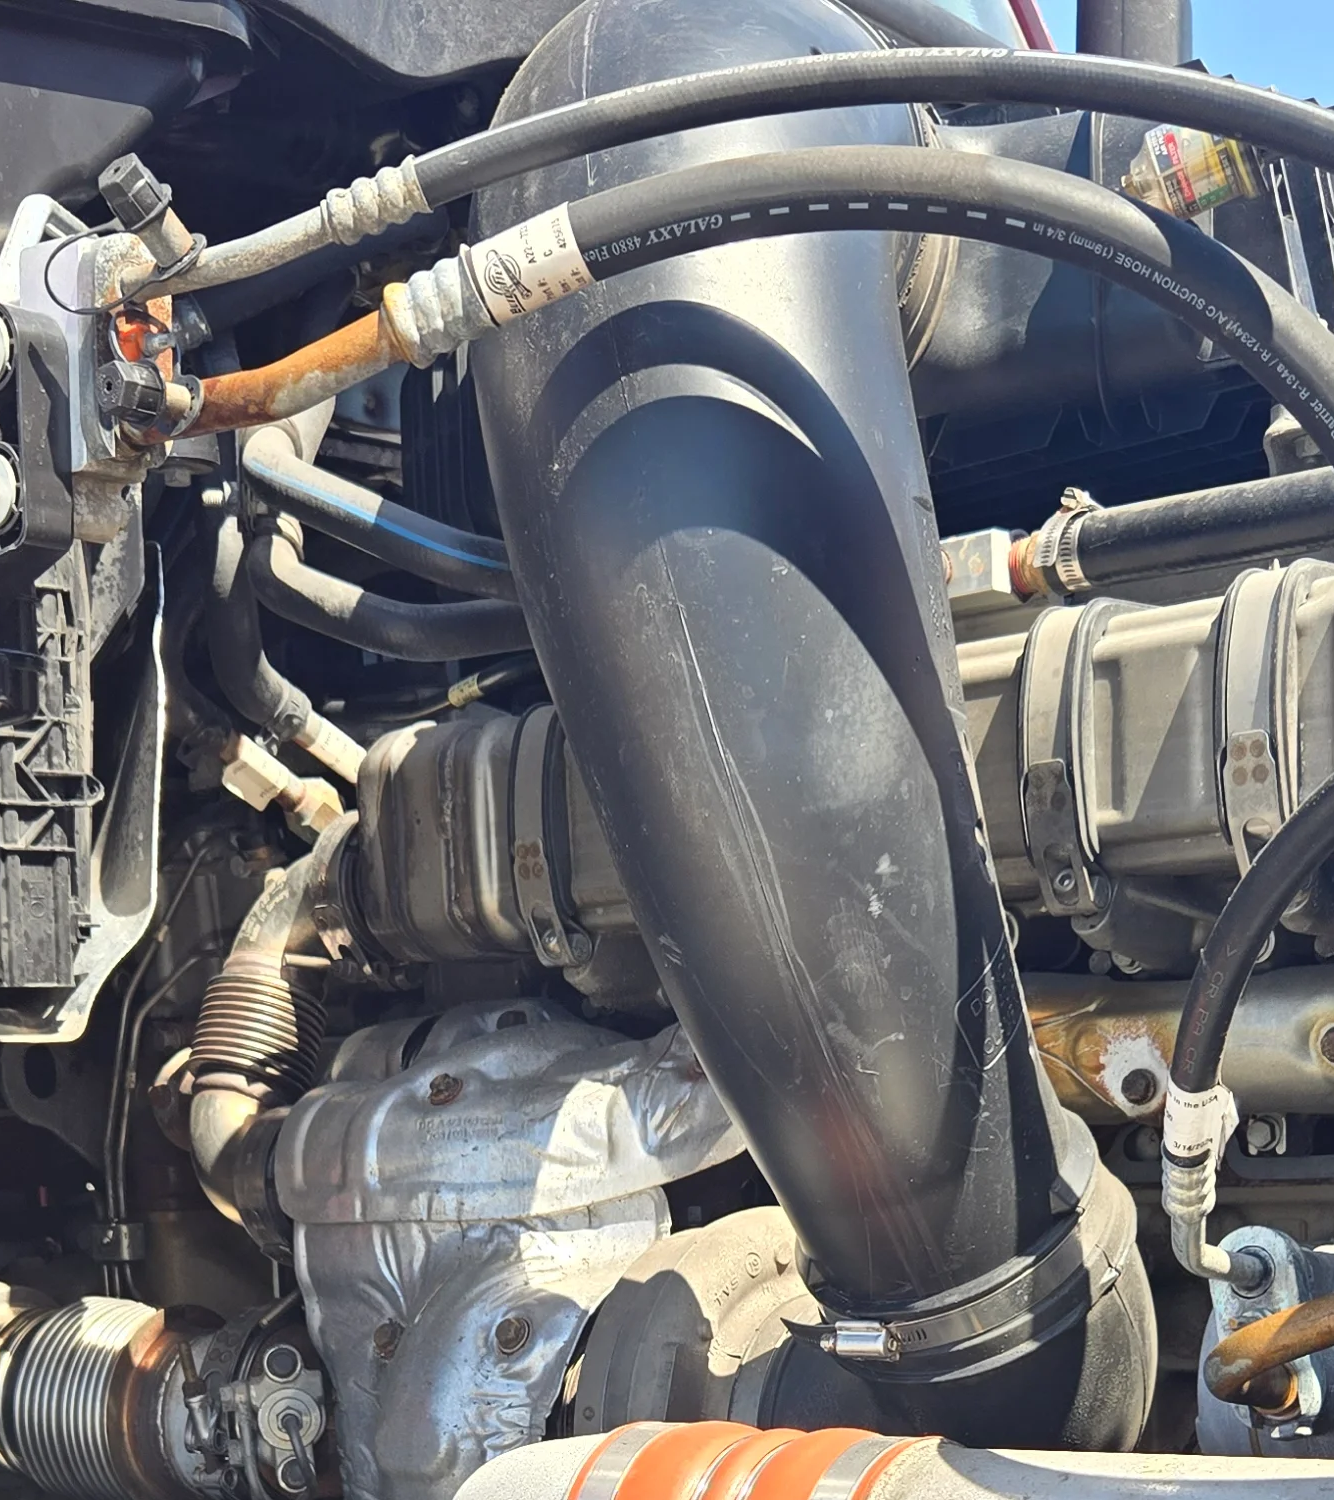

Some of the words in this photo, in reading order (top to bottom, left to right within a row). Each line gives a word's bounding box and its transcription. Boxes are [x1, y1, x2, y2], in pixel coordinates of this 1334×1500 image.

[645, 213, 723, 246] GALAXY
[1046, 225, 1066, 242] 3/4
[611, 235, 642, 256] 4880
[1068, 230, 1115, 260] (19mm)
[1115, 251, 1152, 279] HOSE
[1151, 271, 1207, 311] SUCTION
[1182, 1100, 1200, 1110] the
